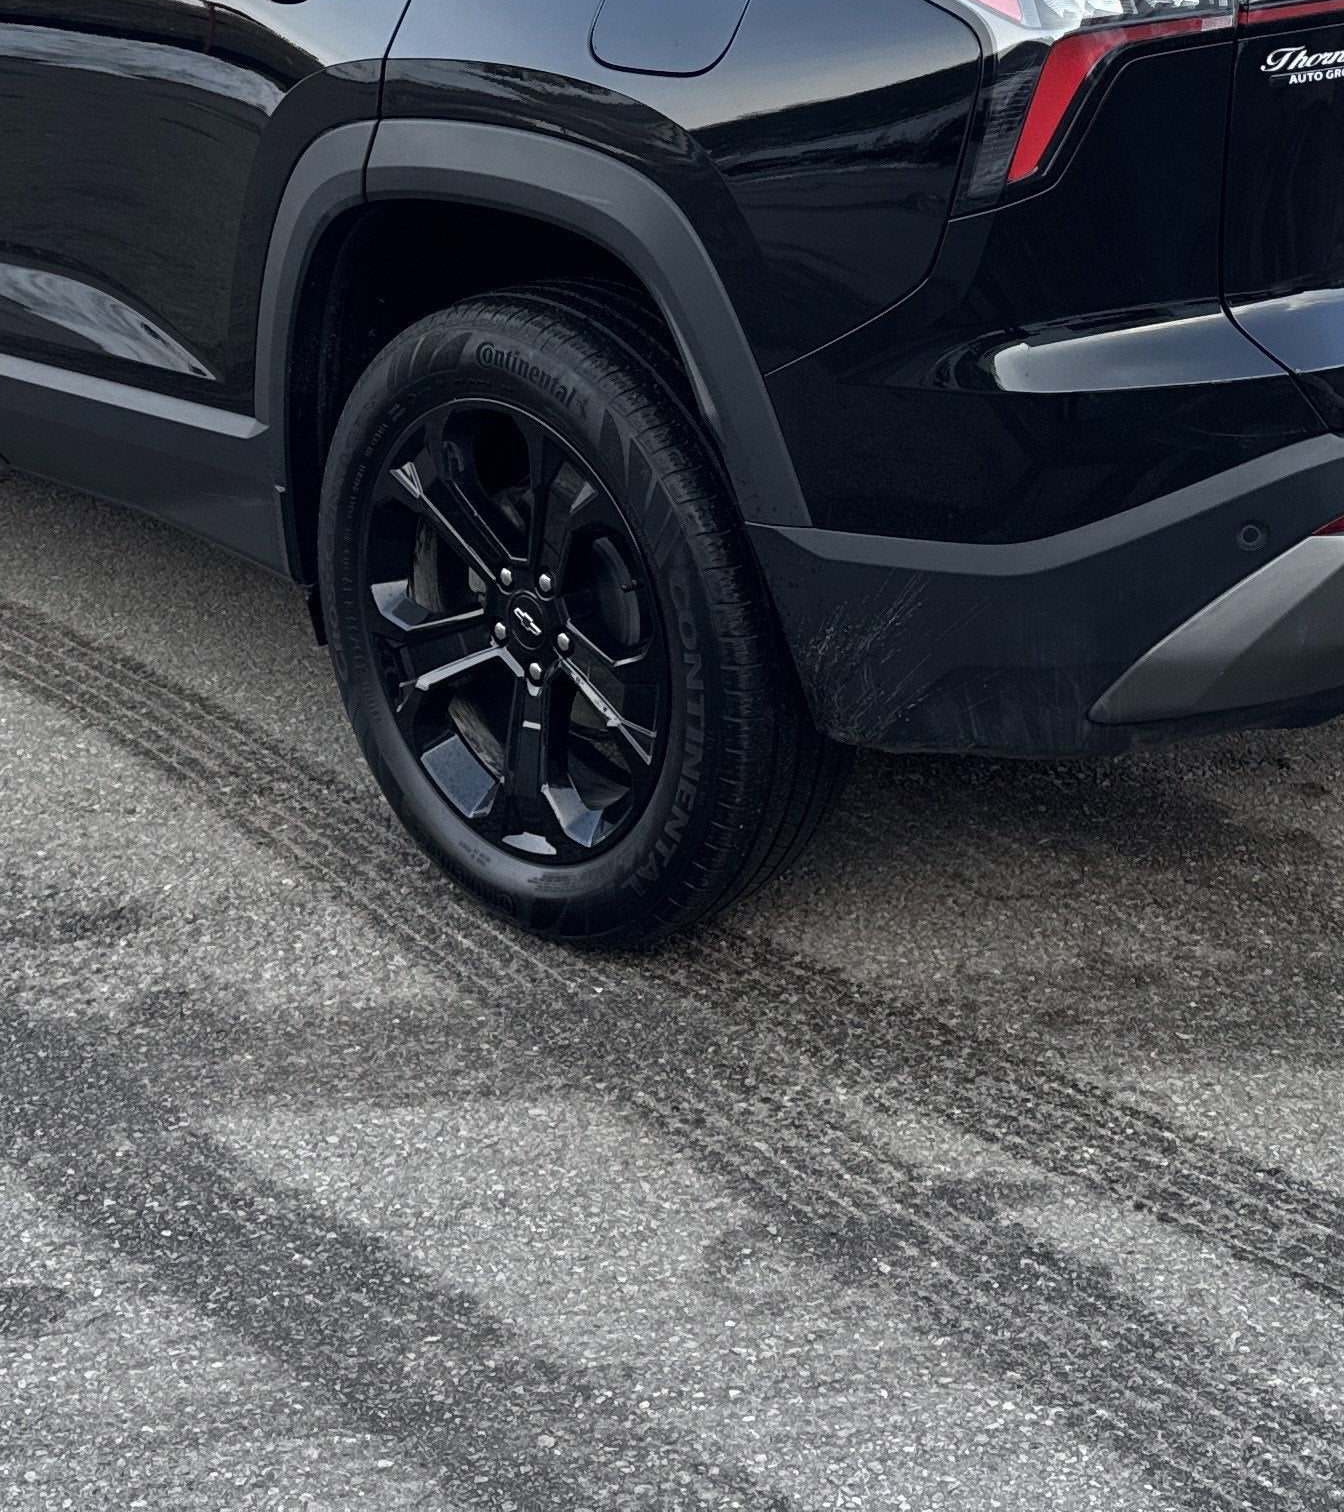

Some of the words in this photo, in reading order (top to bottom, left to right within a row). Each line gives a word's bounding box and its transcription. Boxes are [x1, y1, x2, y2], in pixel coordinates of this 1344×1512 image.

[1289, 71, 1324, 85] AUTO
[475, 340, 578, 409] Continental
[619, 575, 706, 898] CONTINENTAL
